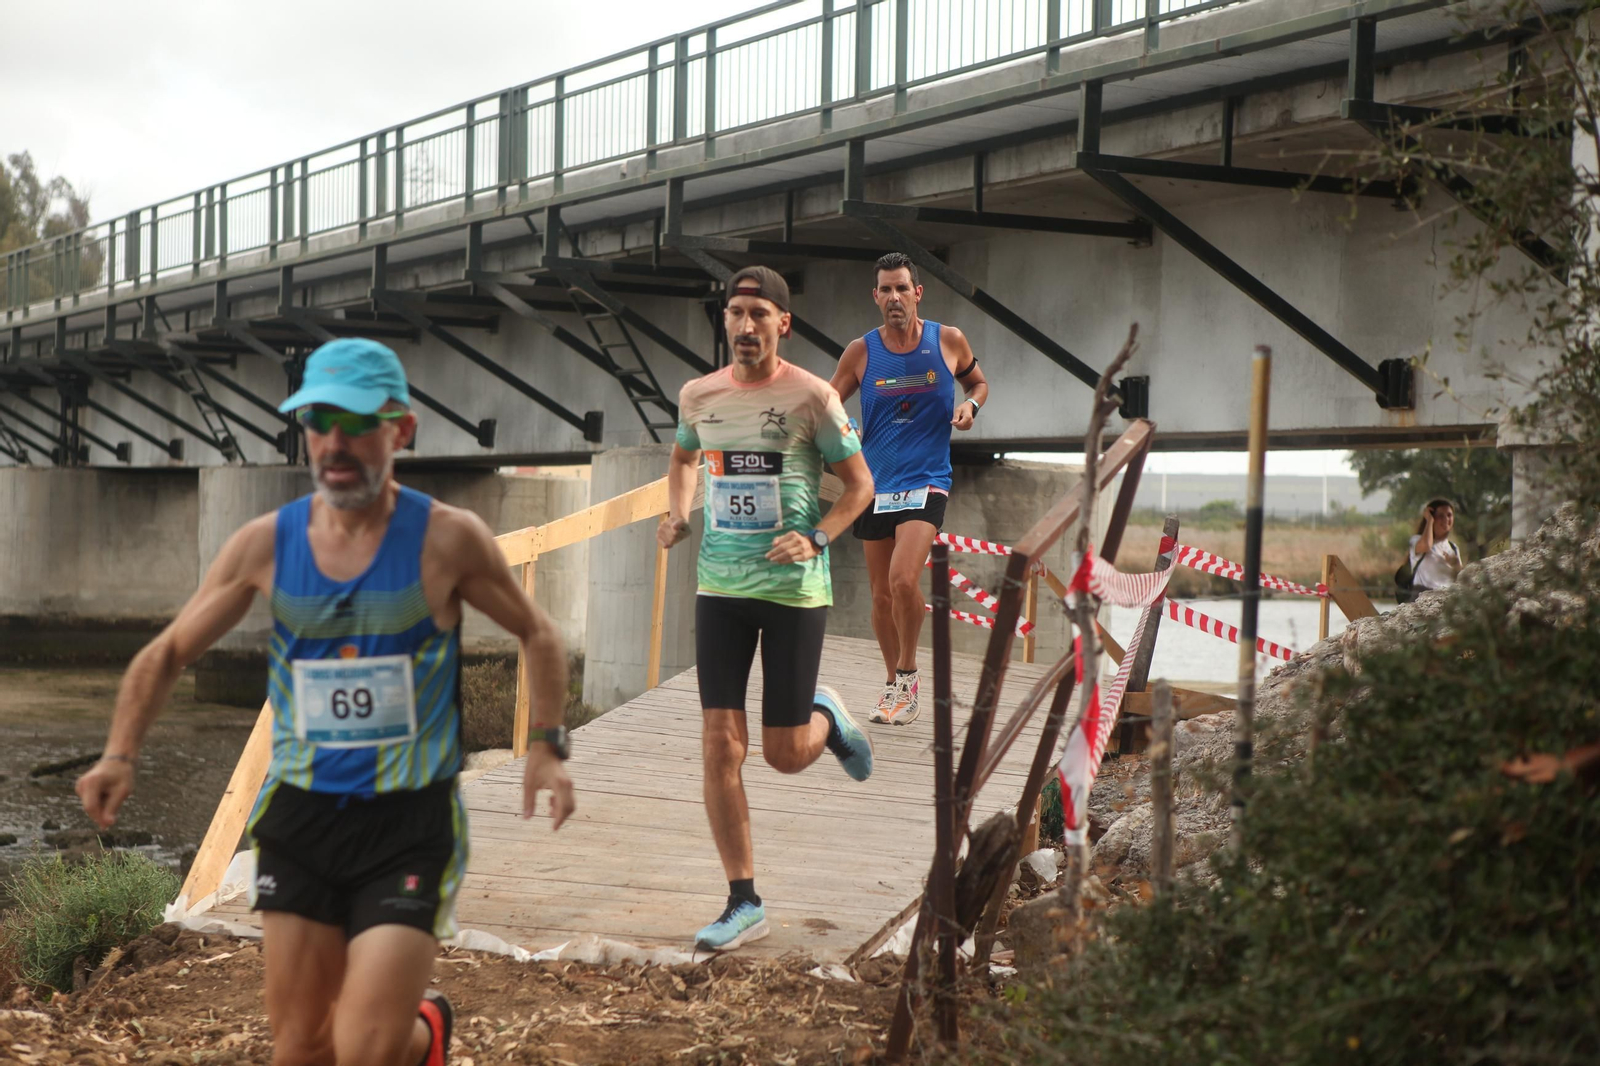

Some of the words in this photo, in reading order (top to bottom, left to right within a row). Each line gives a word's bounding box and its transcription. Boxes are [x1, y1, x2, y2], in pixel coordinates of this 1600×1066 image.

[731, 454, 774, 468] SOL
[730, 495, 756, 515] 55
[332, 688, 373, 720] 69
